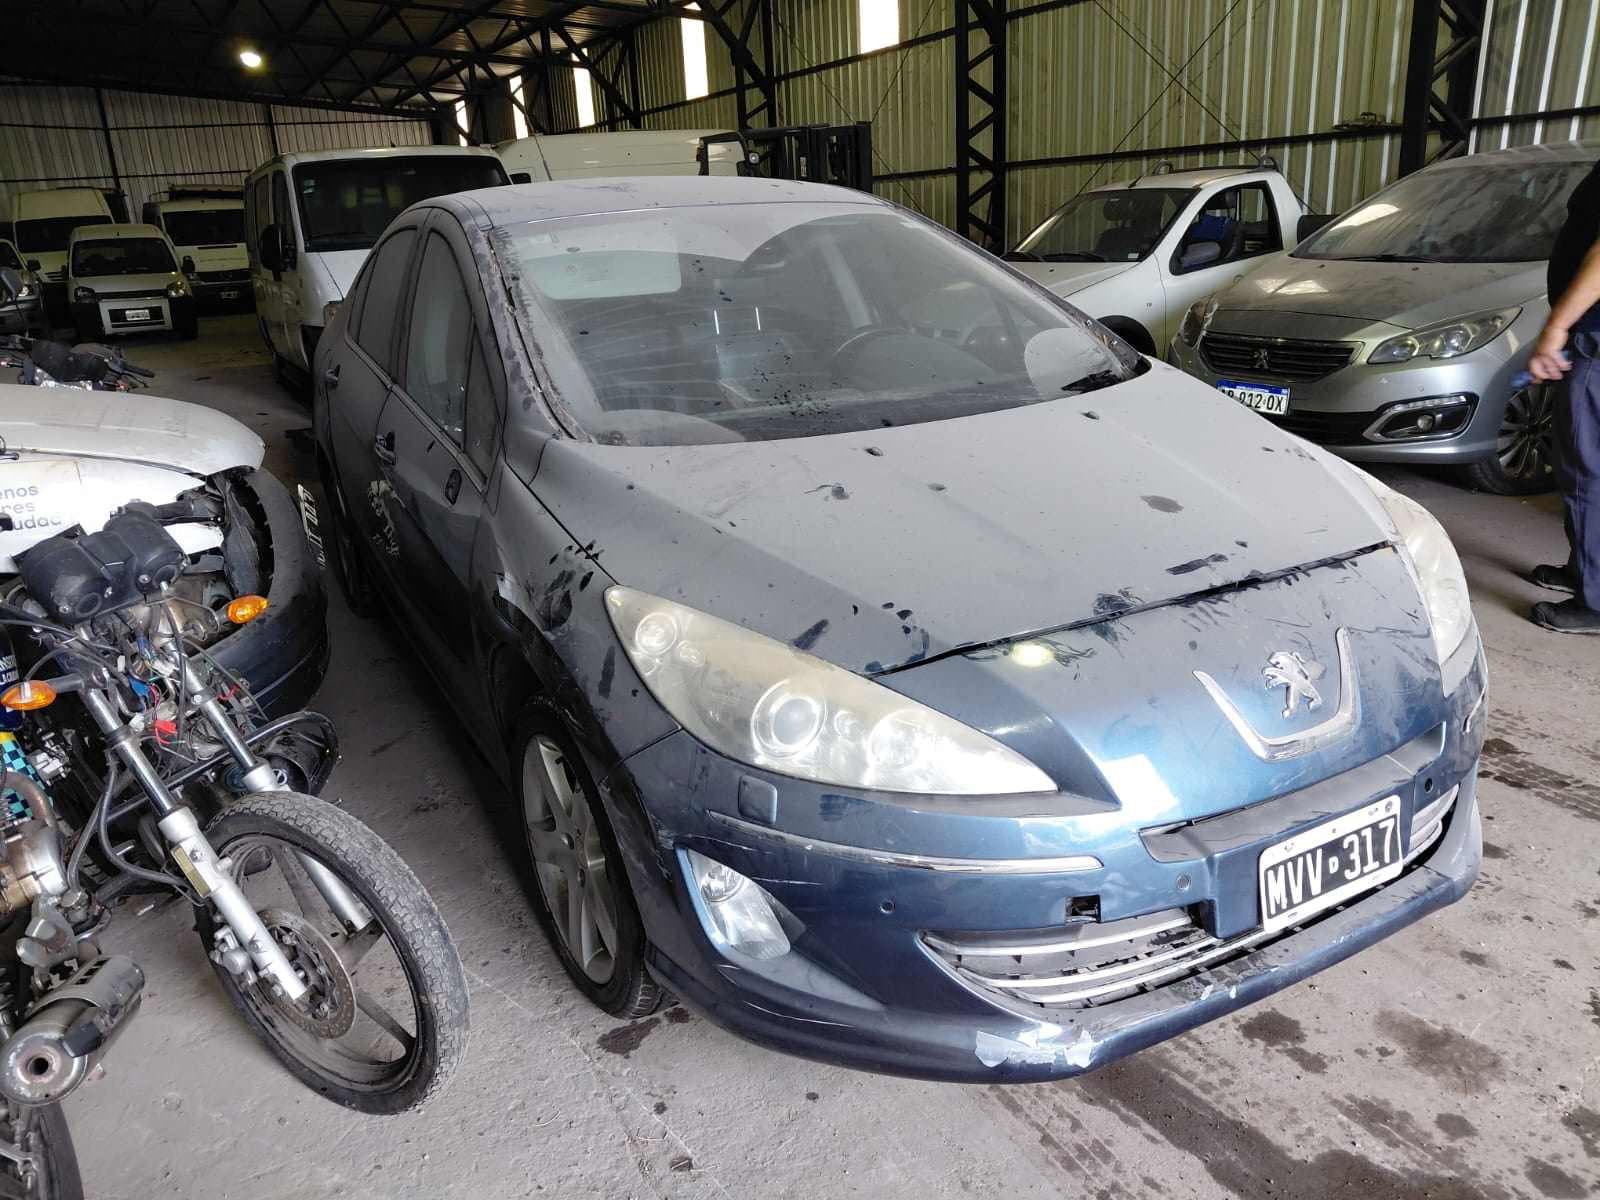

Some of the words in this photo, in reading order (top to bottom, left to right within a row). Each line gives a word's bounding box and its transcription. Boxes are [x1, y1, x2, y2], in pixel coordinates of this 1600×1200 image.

[1240, 391, 1263, 408] 912
[0, 486, 39, 499] nos
[1267, 848, 1323, 916] MVV
[1343, 818, 1396, 881] 317
